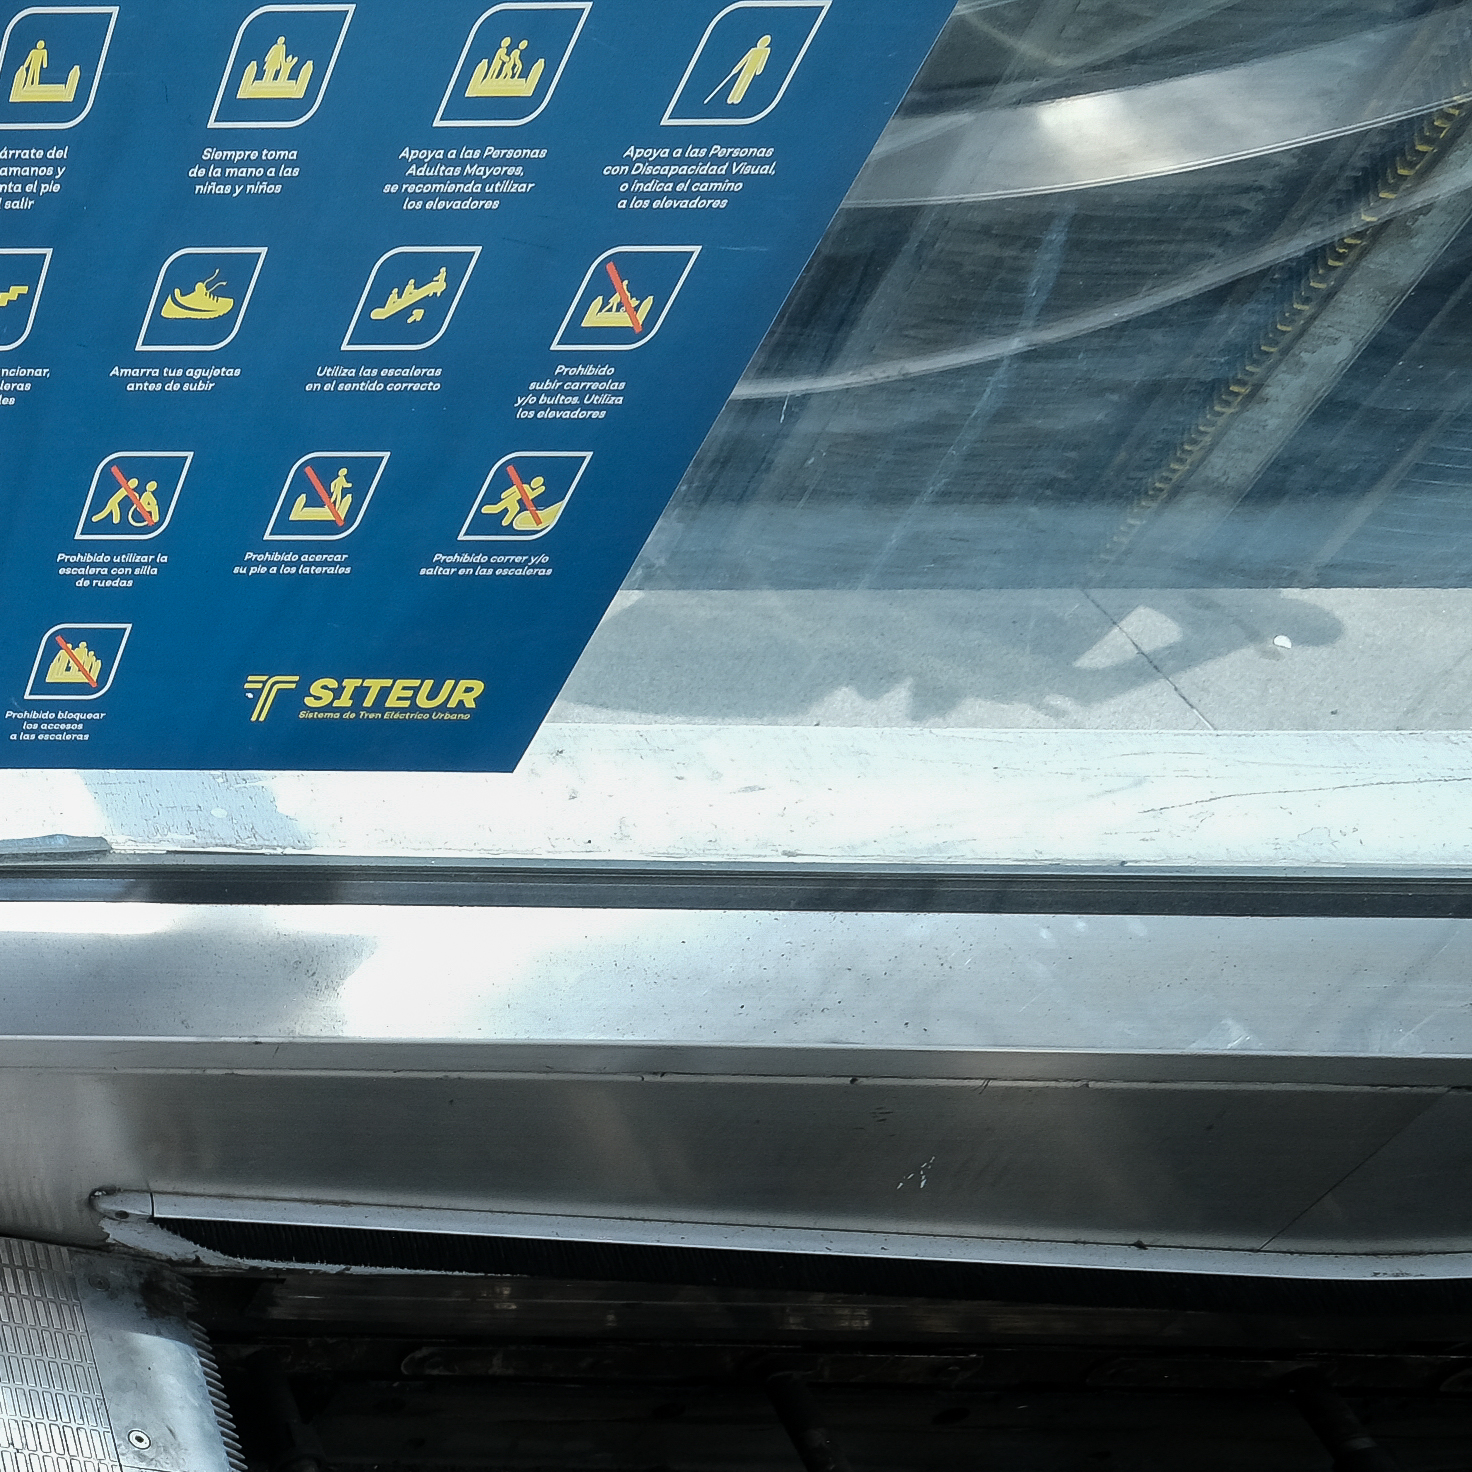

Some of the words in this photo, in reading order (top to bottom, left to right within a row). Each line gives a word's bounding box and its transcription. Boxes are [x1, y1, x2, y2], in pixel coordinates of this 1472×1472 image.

[46, 145, 69, 160] del
[201, 147, 259, 164] Siempre
[261, 148, 298, 161] toma
[398, 146, 445, 163] Apoya
[447, 149, 458, 159] a
[459, 145, 482, 159] las
[482, 145, 548, 159] Personas
[622, 145, 671, 162] Apoya
[672, 147, 683, 158] a
[684, 143, 708, 158] las
[708, 144, 775, 158] Personas
[54, 166, 67, 180] y
[188, 163, 207, 178] de
[207, 163, 222, 178] la
[224, 167, 265, 178] mano
[266, 167, 276, 177] a
[278, 163, 301, 177] las
[405, 162, 462, 177] Adultas
[462, 163, 524, 180] Mayores,
[602, 165, 630, 176] con
[630, 160, 730, 179] Discapacidad
[731, 160, 777, 176] Visual,
[24, 179, 38, 193] el
[39, 179, 61, 197] pie
[194, 180, 232, 195] niñas
[232, 184, 245, 198] y
[245, 180, 283, 195] niños
[382, 183, 399, 194] se
[401, 179, 483, 194] recomienda
[484, 179, 536, 193] utilizar
[619, 182, 629, 192] o
[630, 178, 674, 193] indica
[675, 178, 692, 192] el
[691, 178, 744, 192] camino
[3, 196, 35, 210] salir
[402, 196, 424, 210] los
[425, 196, 500, 210] elevadores
[617, 199, 628, 209] a
[628, 195, 651, 209] los
[652, 195, 729, 209] elevadores
[109, 365, 160, 378] Amarra
[162, 366, 184, 377] tus
[185, 365, 242, 380] agujetas
[316, 365, 357, 378] Utiliza
[358, 365, 379, 377] las
[380, 365, 443, 377] escaleras
[554, 363, 615, 376] Prohibido
[126, 380, 163, 392] antes
[164, 379, 181, 392] de
[182, 379, 216, 392] subir
[305, 382, 322, 392] en
[323, 379, 337, 392] el
[337, 379, 385, 392] sentido
[385, 381, 441, 392] correcto
[528, 378, 564, 391] subir
[563, 378, 627, 391] carreolas
[513, 393, 537, 408] y/o
[538, 392, 581, 405] bultos.
[583, 393, 624, 405] Utiliza
[516, 407, 536, 419] los
[536, 406, 607, 419] elevadores
[56, 552, 112, 563] Prohibido
[112, 552, 156, 564] utilizar
[155, 552, 169, 564] la
[243, 551, 299, 562] Prohibido
[300, 553, 349, 562] acercar
[432, 552, 489, 564] Prohibido
[489, 555, 529, 564] correr
[527, 553, 550, 566] y/o
[58, 564, 109, 576] escalera
[110, 567, 133, 576] con
[133, 564, 159, 576] silla
[232, 565, 248, 574] su
[248, 563, 268, 577] pie
[279, 563, 297, 575] los
[298, 563, 352, 575] laterales
[418, 565, 458, 576] saltar
[457, 567, 474, 576] en
[474, 564, 495, 576] las
[494, 565, 553, 576] escaleras
[75, 577, 91, 588] de
[92, 577, 134, 588] ruedas
[303, 677, 486, 709] SITEUR
[4, 709, 56, 720] Prohibido
[56, 710, 107, 722] bloquear
[297, 709, 341, 720] Sistema
[342, 710, 357, 720] de
[358, 710, 383, 720] Tren
[431, 710, 471, 721] Urbano
[22, 720, 39, 730] los
[40, 722, 84, 731] accesos
[19, 731, 36, 741] las
[37, 731, 90, 741] escaleras
